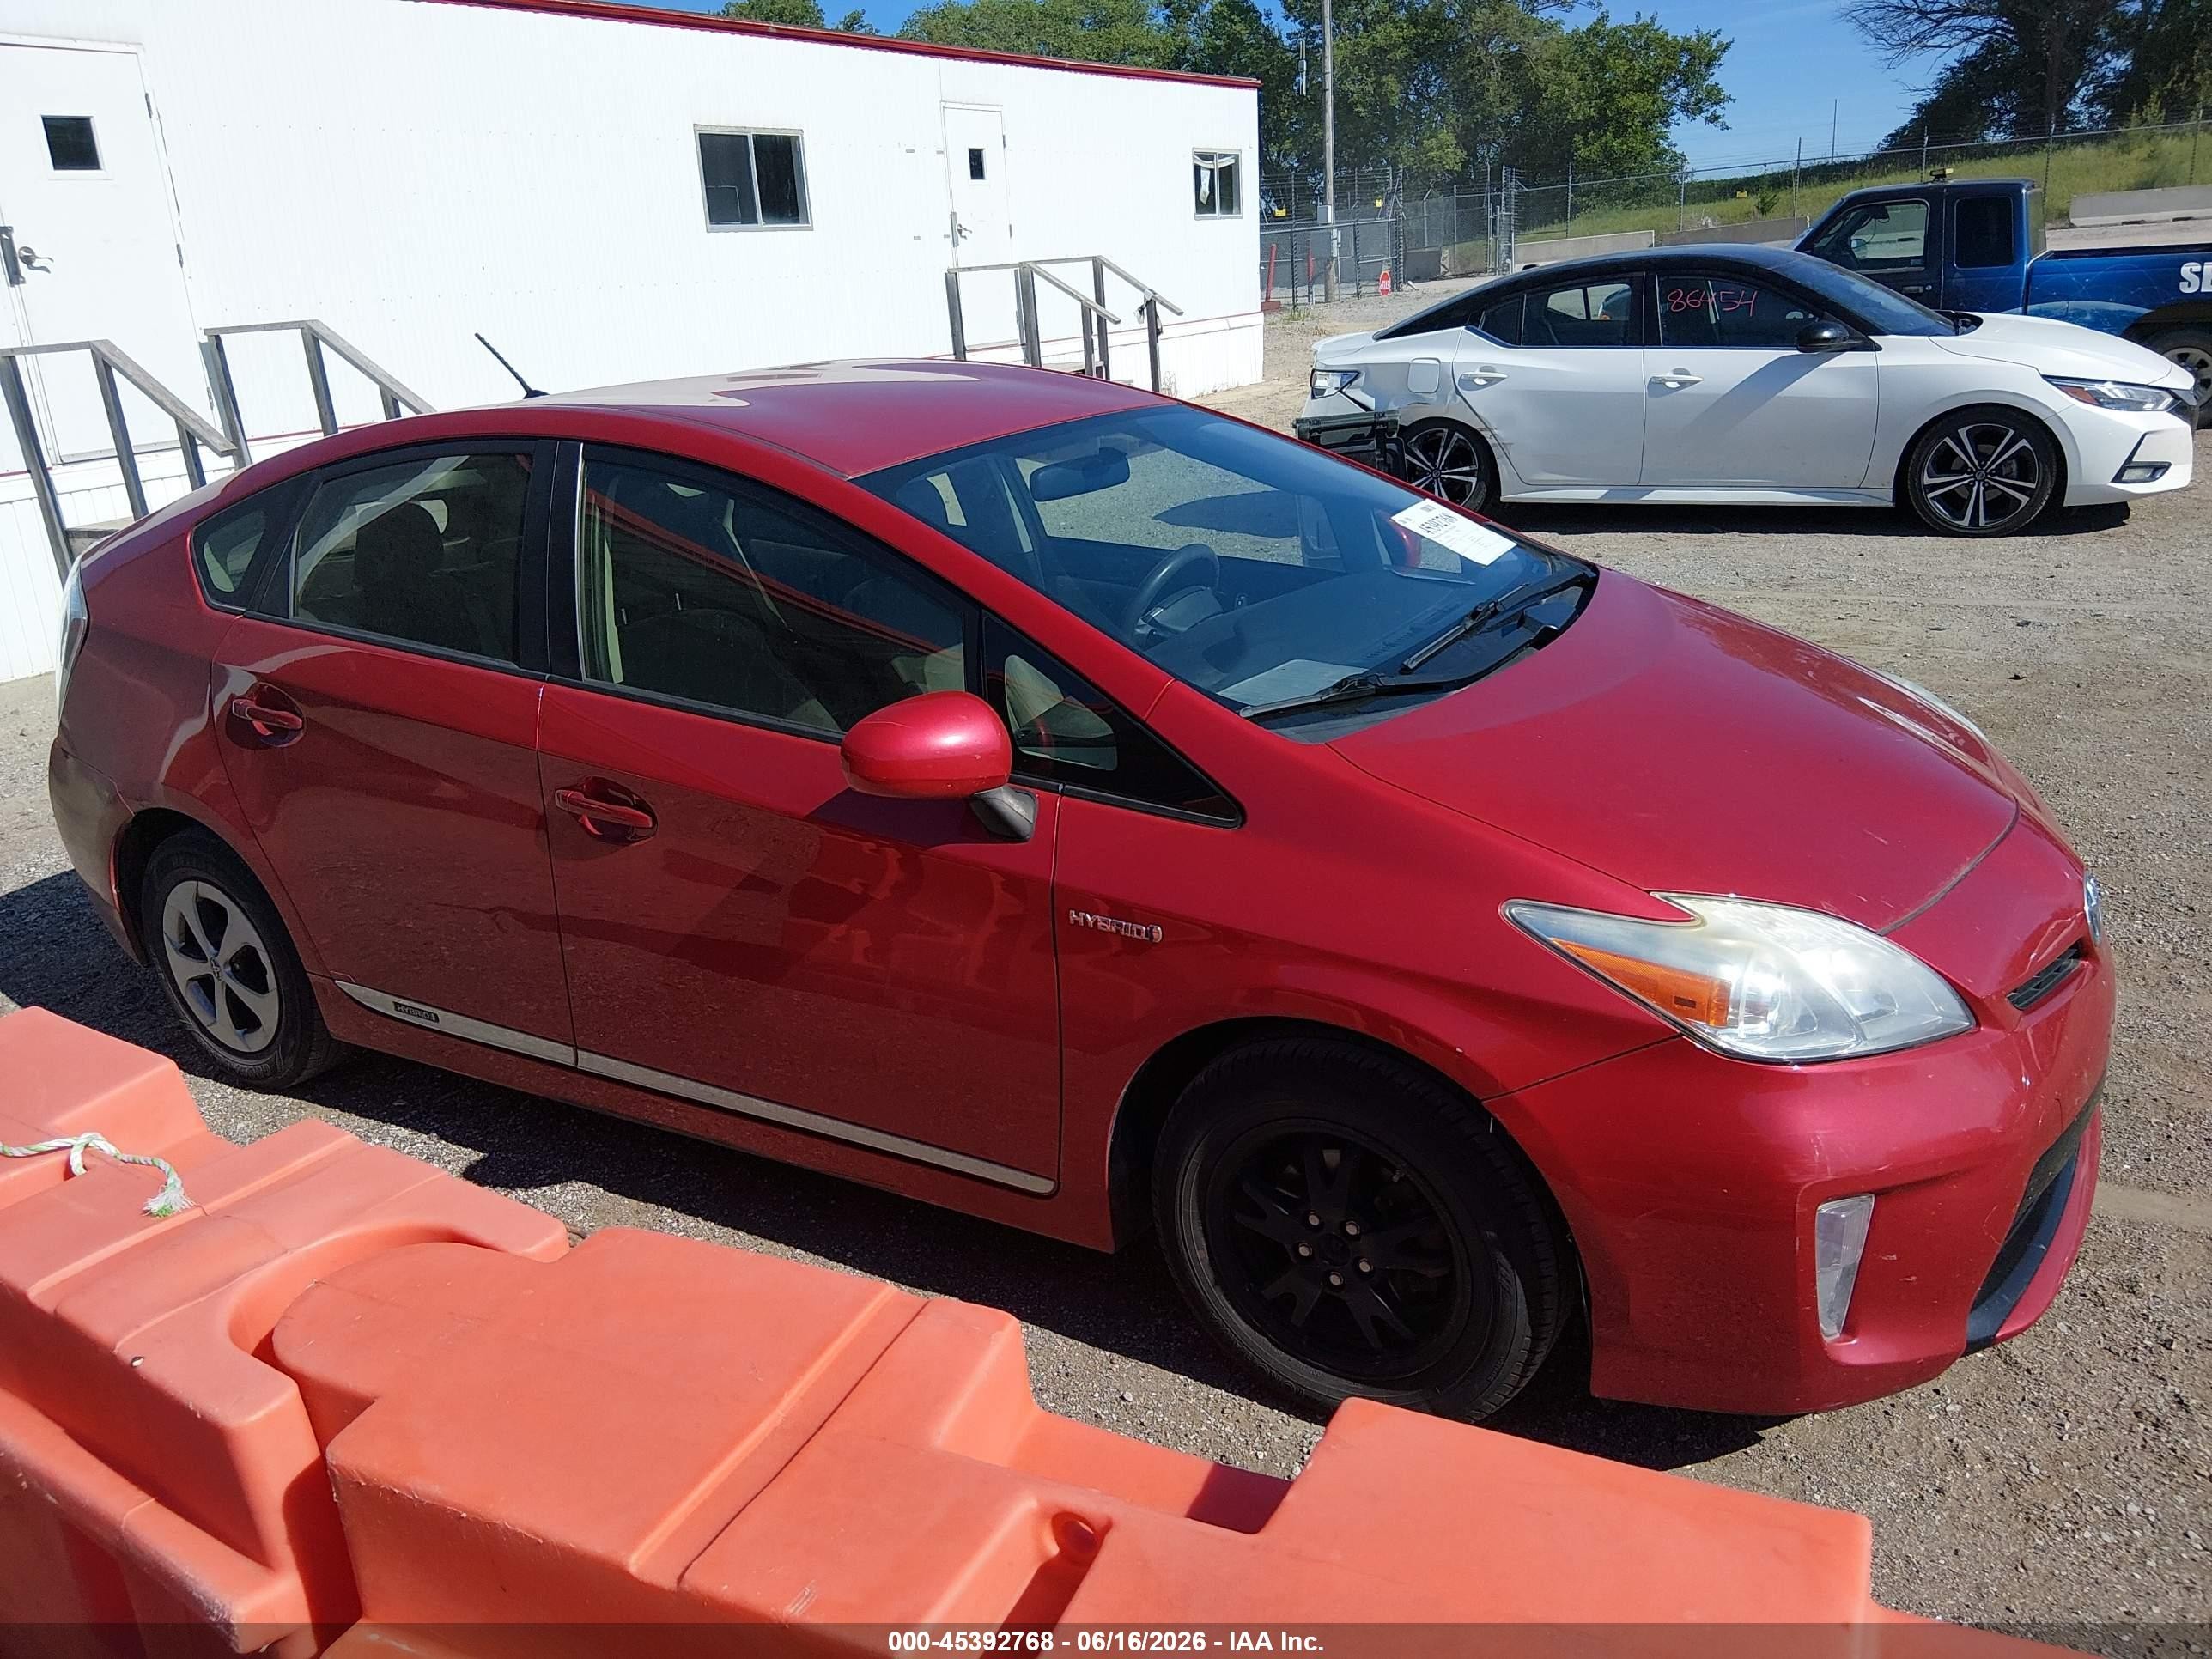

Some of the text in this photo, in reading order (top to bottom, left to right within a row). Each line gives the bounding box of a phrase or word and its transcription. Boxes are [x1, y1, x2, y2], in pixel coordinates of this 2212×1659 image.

[1668, 288, 1758, 316] 86454
[1069, 909, 1148, 940] HYBRID
[397, 1003, 430, 1019] HYBRID
